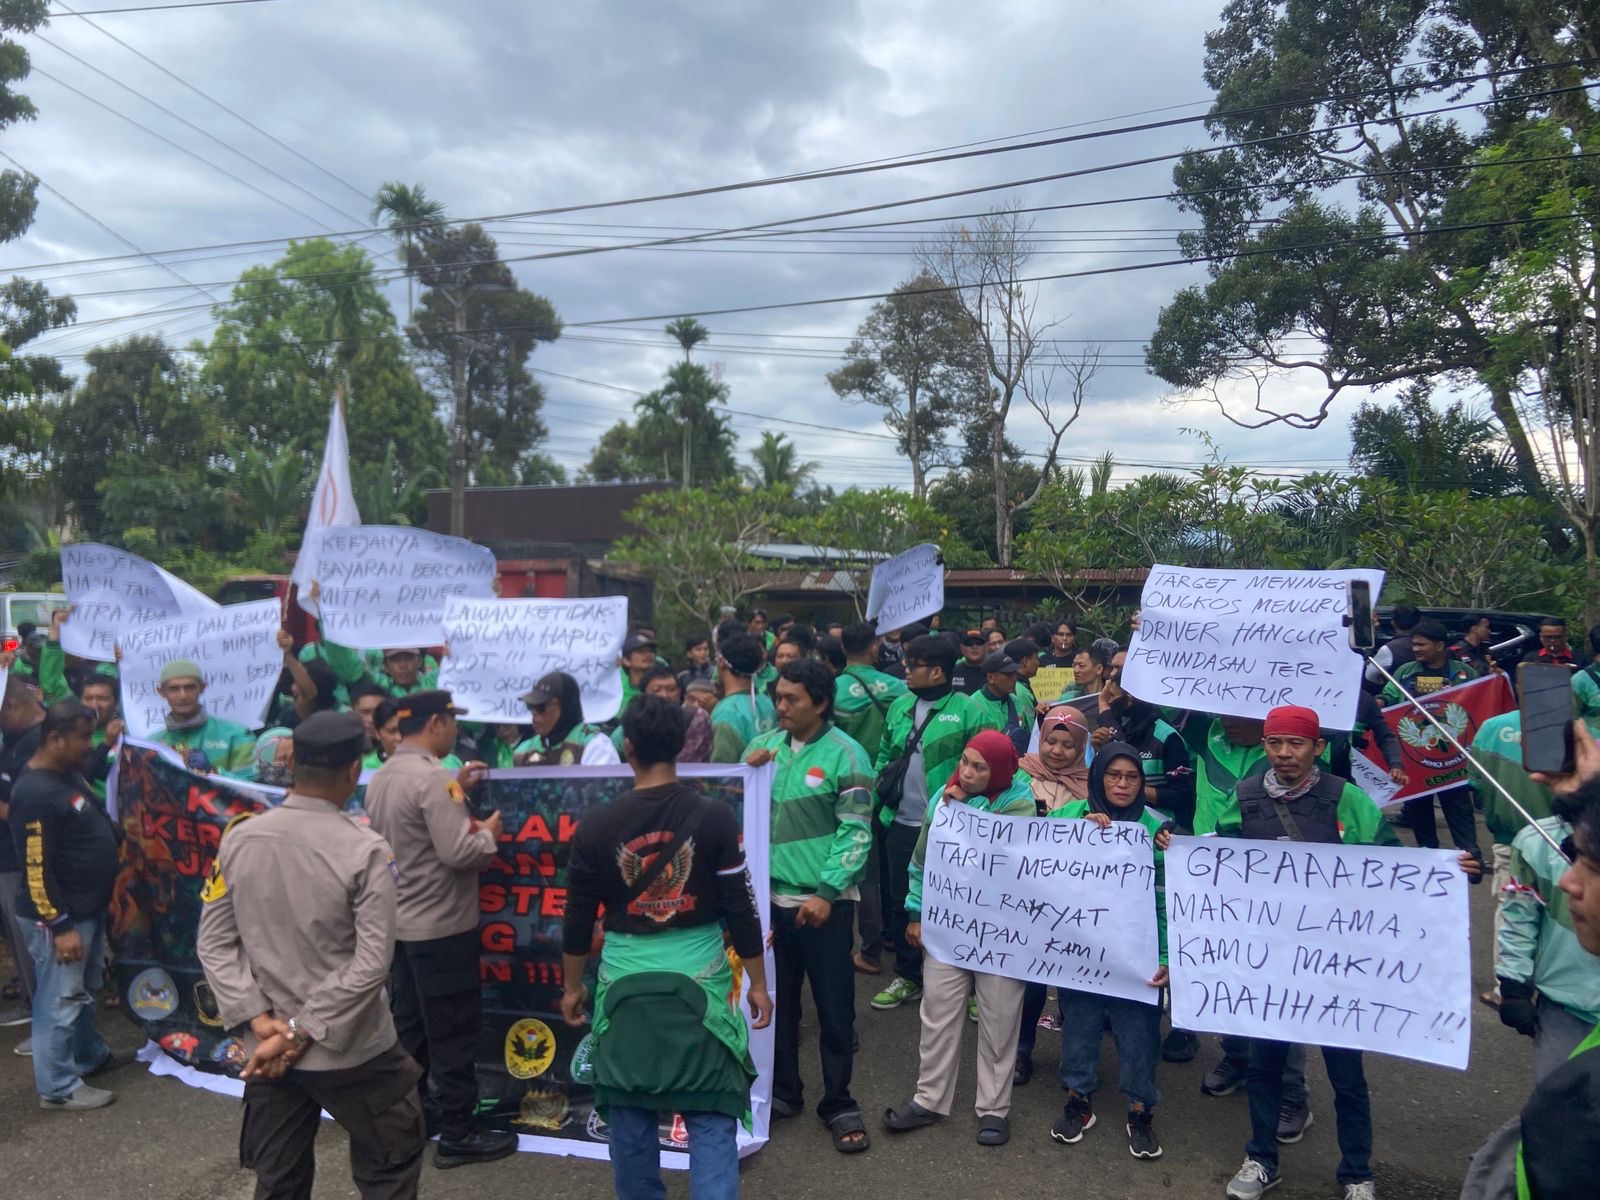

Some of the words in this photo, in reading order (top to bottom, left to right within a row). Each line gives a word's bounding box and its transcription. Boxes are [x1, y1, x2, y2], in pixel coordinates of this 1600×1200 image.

[317, 559, 404, 586] BAYARAN
[1156, 572, 1237, 590] TARGET
[1244, 576, 1347, 591] MENINGG
[320, 586, 386, 606] MITRA
[1145, 591, 1242, 616] ONGKOS
[1251, 598, 1351, 615] MENURU
[196, 617, 227, 637] DAN
[446, 602, 518, 623] LAWAN
[221, 630, 270, 658] MIMPI
[540, 626, 613, 651] HAPUS
[1140, 619, 1220, 645] DRIVER
[1231, 621, 1339, 652] HANCUR
[539, 653, 612, 673] TOLAK
[1131, 647, 1257, 674] PENINDASAN
[1268, 660, 1333, 679] TER-
[1160, 676, 1296, 707] STRUKTUR
[936, 805, 1014, 845] SISTEM
[935, 840, 1009, 877] TARIF
[1016, 855, 1156, 891] MENGHIMPIT
[1187, 846, 1455, 897] GRRAAABBB
[928, 870, 991, 908] WAKIL
[1172, 892, 1283, 926] MAKIN
[927, 906, 1029, 948] HARAPAN
[1044, 936, 1107, 963] KAMI
[952, 943, 1015, 969] SAAT
[1027, 957, 1063, 978] INI
[1178, 934, 1270, 970] KAMU
[1293, 945, 1423, 984] MAKIN
[1190, 980, 1419, 1039] JAAHHAATT
